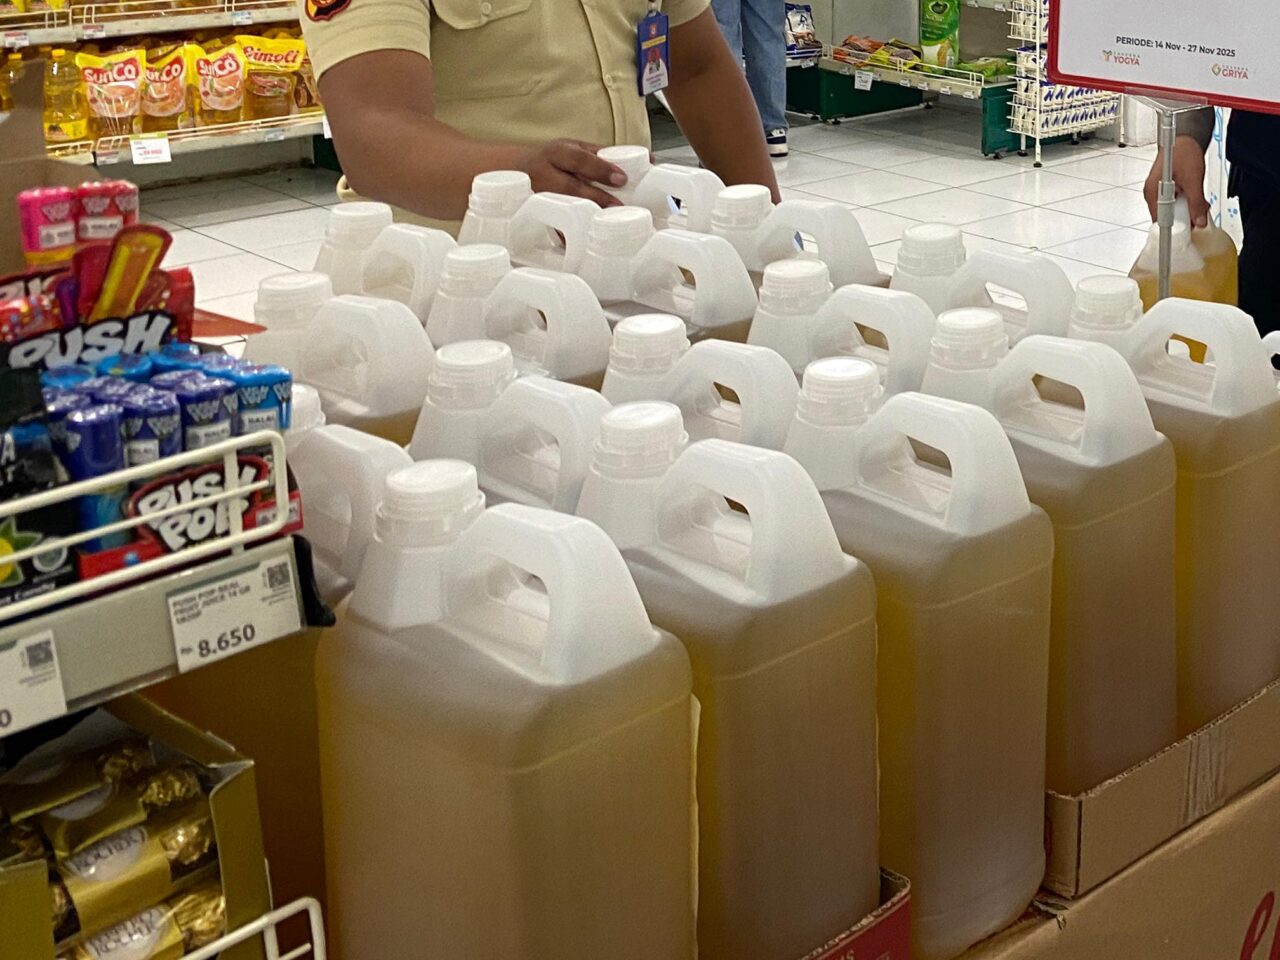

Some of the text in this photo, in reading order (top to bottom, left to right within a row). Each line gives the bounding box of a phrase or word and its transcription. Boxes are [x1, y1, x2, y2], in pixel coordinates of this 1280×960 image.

[243, 46, 300, 64] Bimoli
[1115, 35, 1154, 48] PERIODE:
[1154, 40, 1164, 49] 14
[1165, 42, 1181, 51] Nov
[1187, 44, 1197, 53] 27
[1199, 46, 1215, 55] Nov
[1216, 48, 1236, 58] 2025
[199, 58, 237, 76] SunCo
[1113, 55, 1141, 66] YOGYA
[84, 63, 137, 85] SunCo
[1221, 69, 1249, 80] GRIYA
[8, 312, 173, 370] PUSH
[198, 624, 256, 658] 8.650
